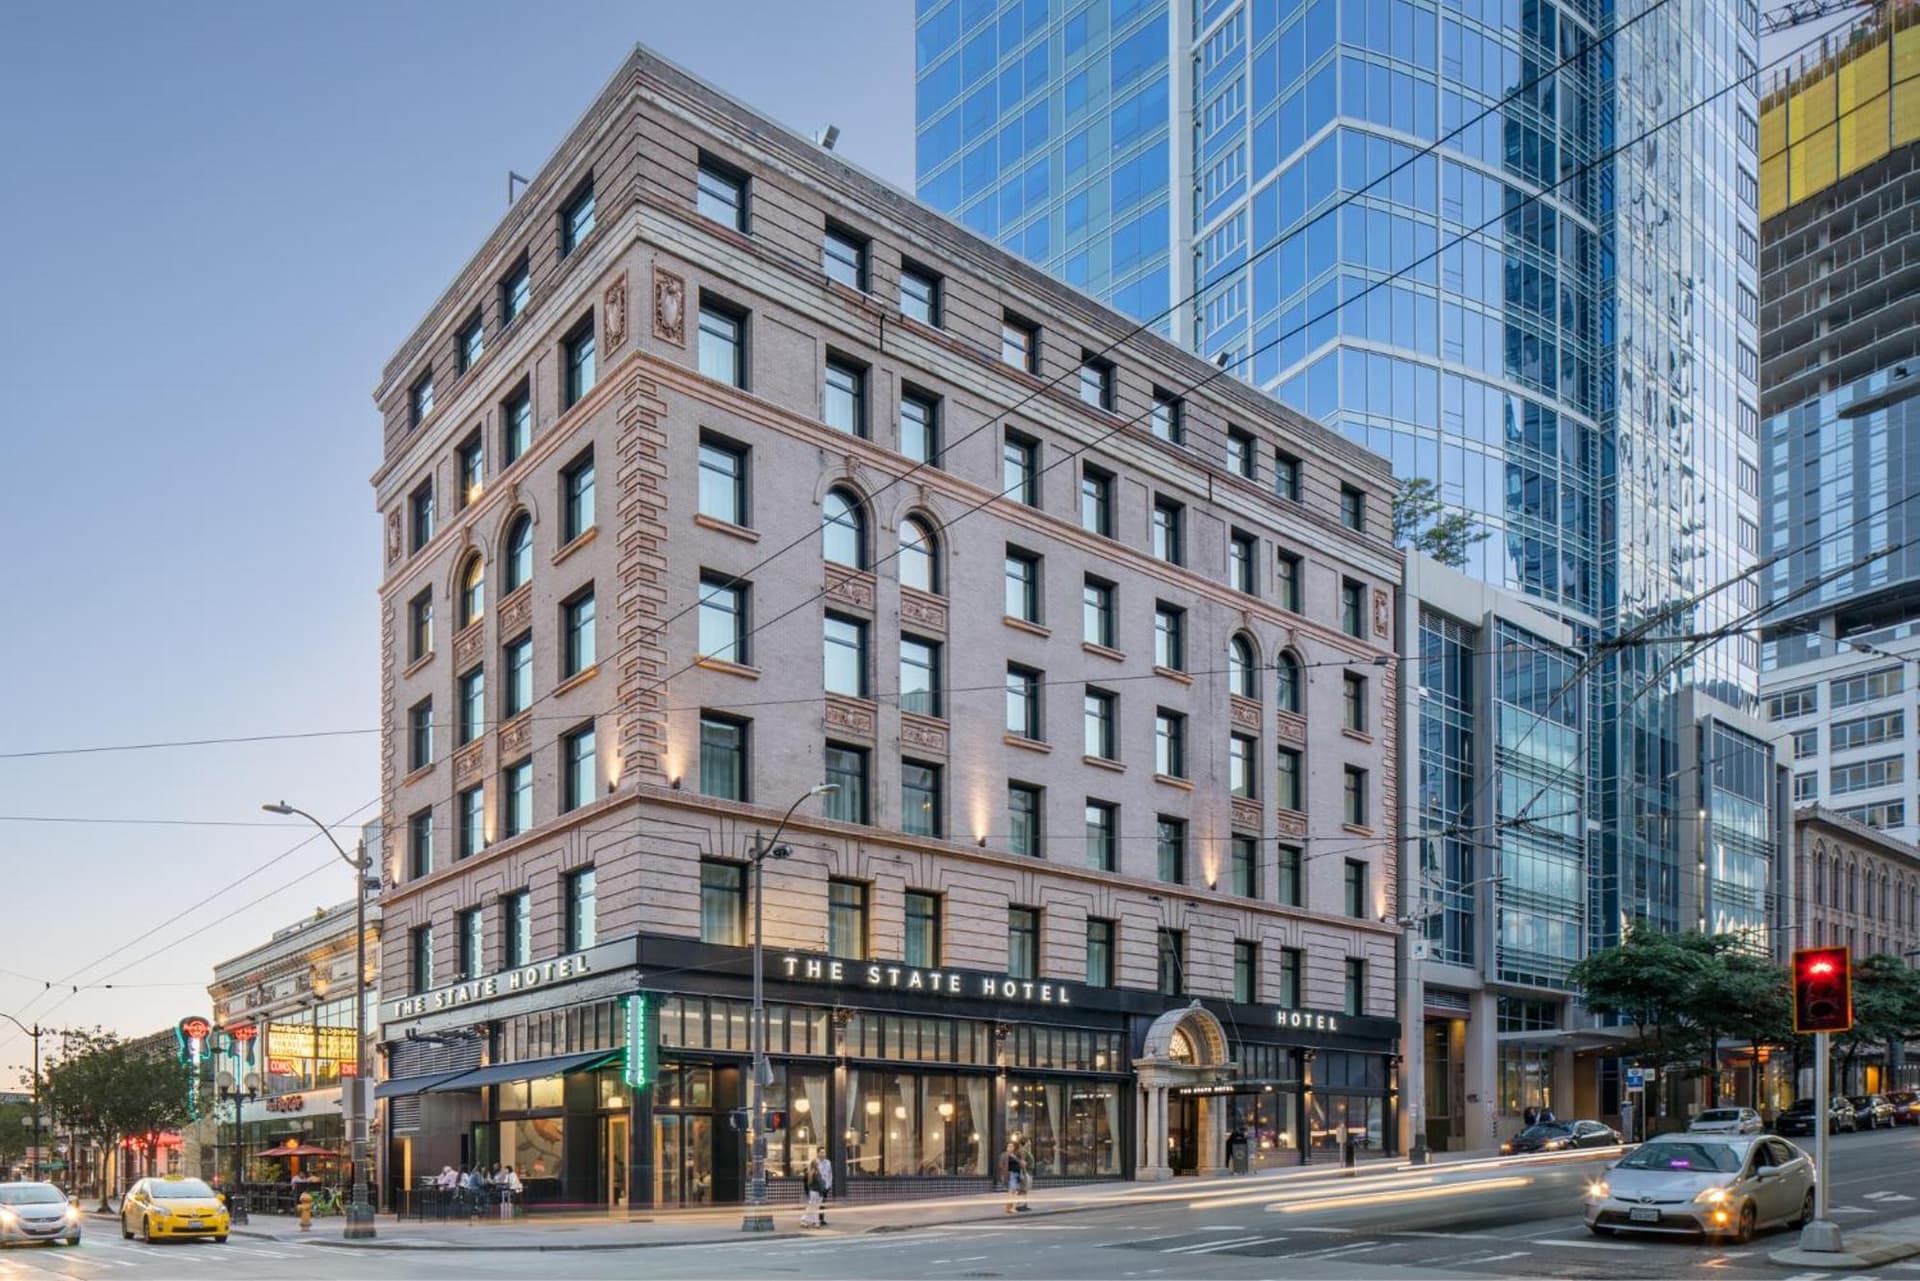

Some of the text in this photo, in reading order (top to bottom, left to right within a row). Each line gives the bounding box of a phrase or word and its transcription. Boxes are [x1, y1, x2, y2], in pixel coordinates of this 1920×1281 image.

[394, 954, 591, 1018] THE STATE HOTEL
[782, 956, 1071, 1004] THE STATE HOTEL
[1277, 1010, 1338, 1031] HOTEL
